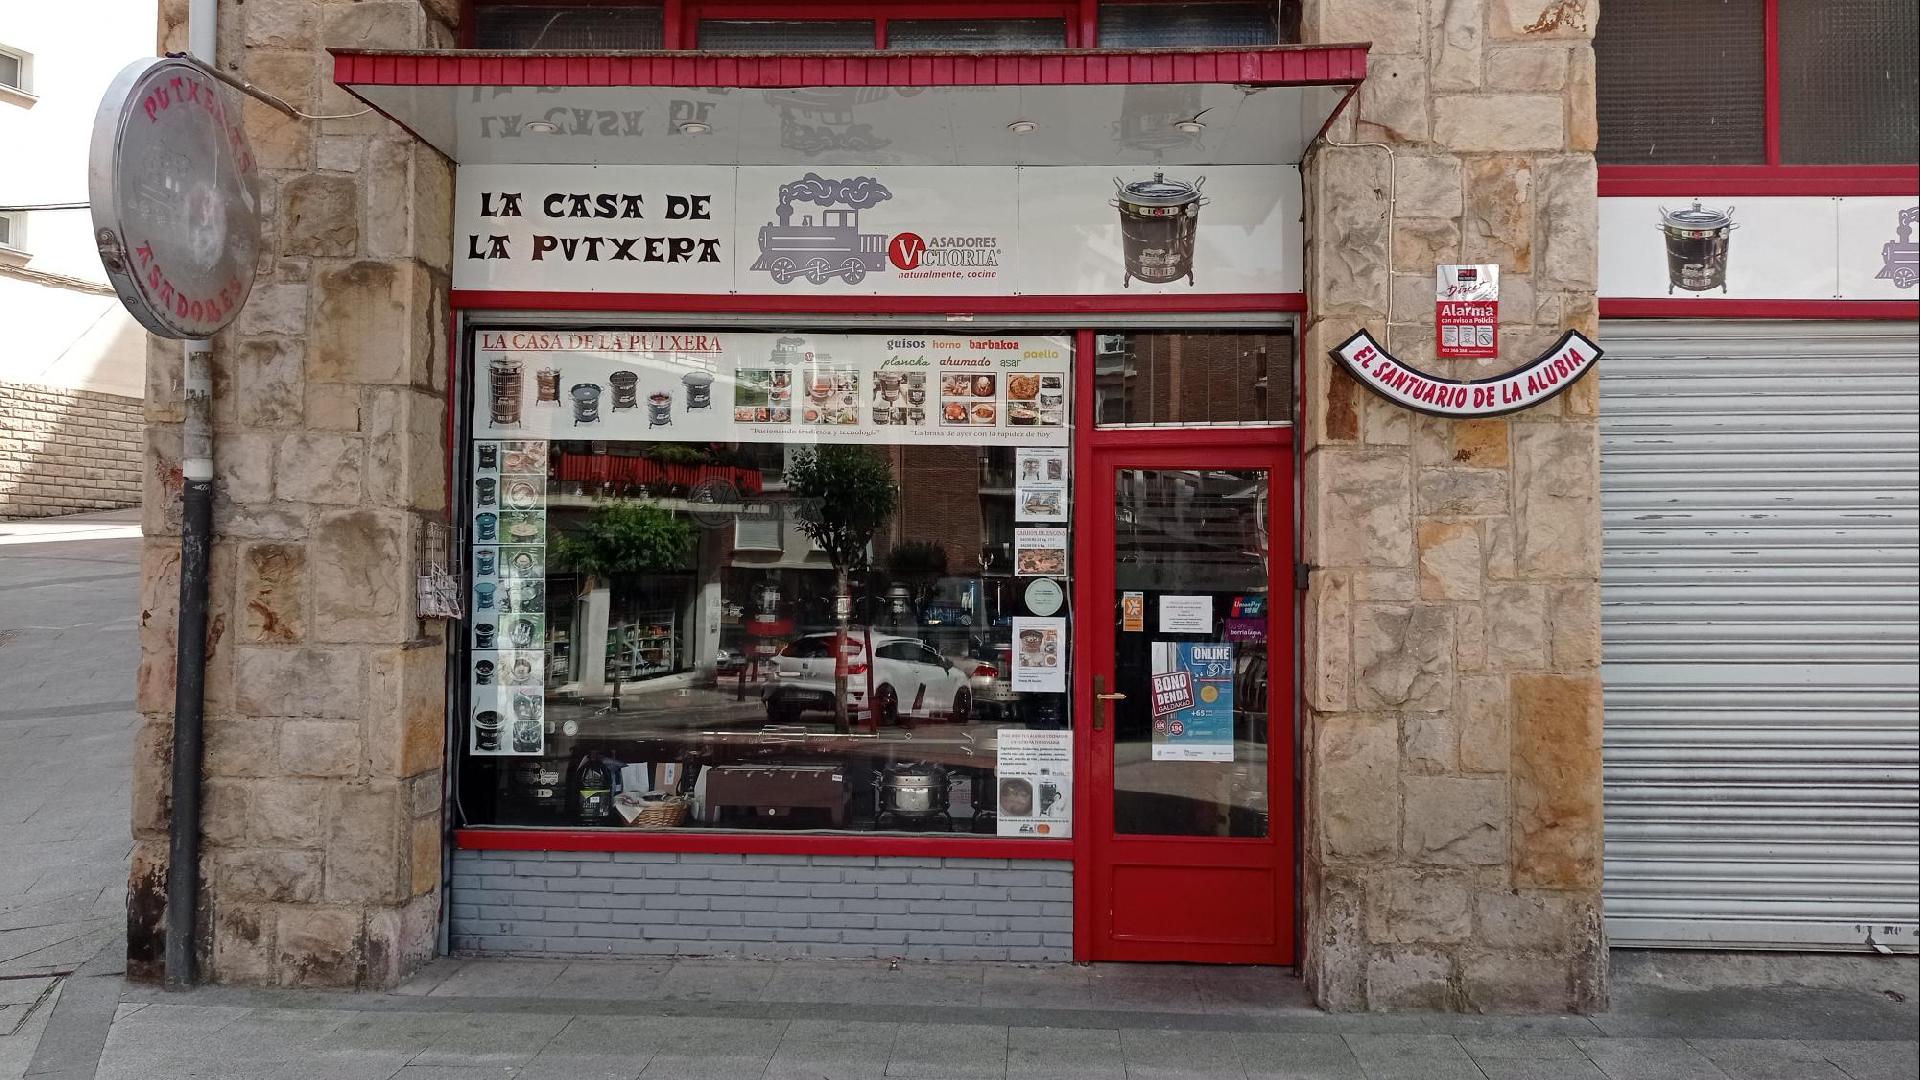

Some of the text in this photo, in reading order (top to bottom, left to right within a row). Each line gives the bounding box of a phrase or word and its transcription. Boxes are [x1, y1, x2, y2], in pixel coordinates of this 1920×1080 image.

[480, 192, 712, 220] LA CASA DE
[468, 234, 511, 260] LA
[929, 237, 997, 248] ASADORES
[136, 240, 242, 323] ASADORES
[1441, 303, 1494, 316] Alarma
[482, 333, 723, 351] LA CASA DE LA PUTXERA
[887, 338, 1019, 350] guisos horno barbakoa
[881, 355, 1021, 370] plancha ahumado asar
[1353, 346, 1586, 409] EL SANTUARIO DE LA ALUBIA
[1194, 647, 1229, 660] ONLINE
[1154, 673, 1188, 693] BONO
[1156, 688, 1190, 706] DENDA
